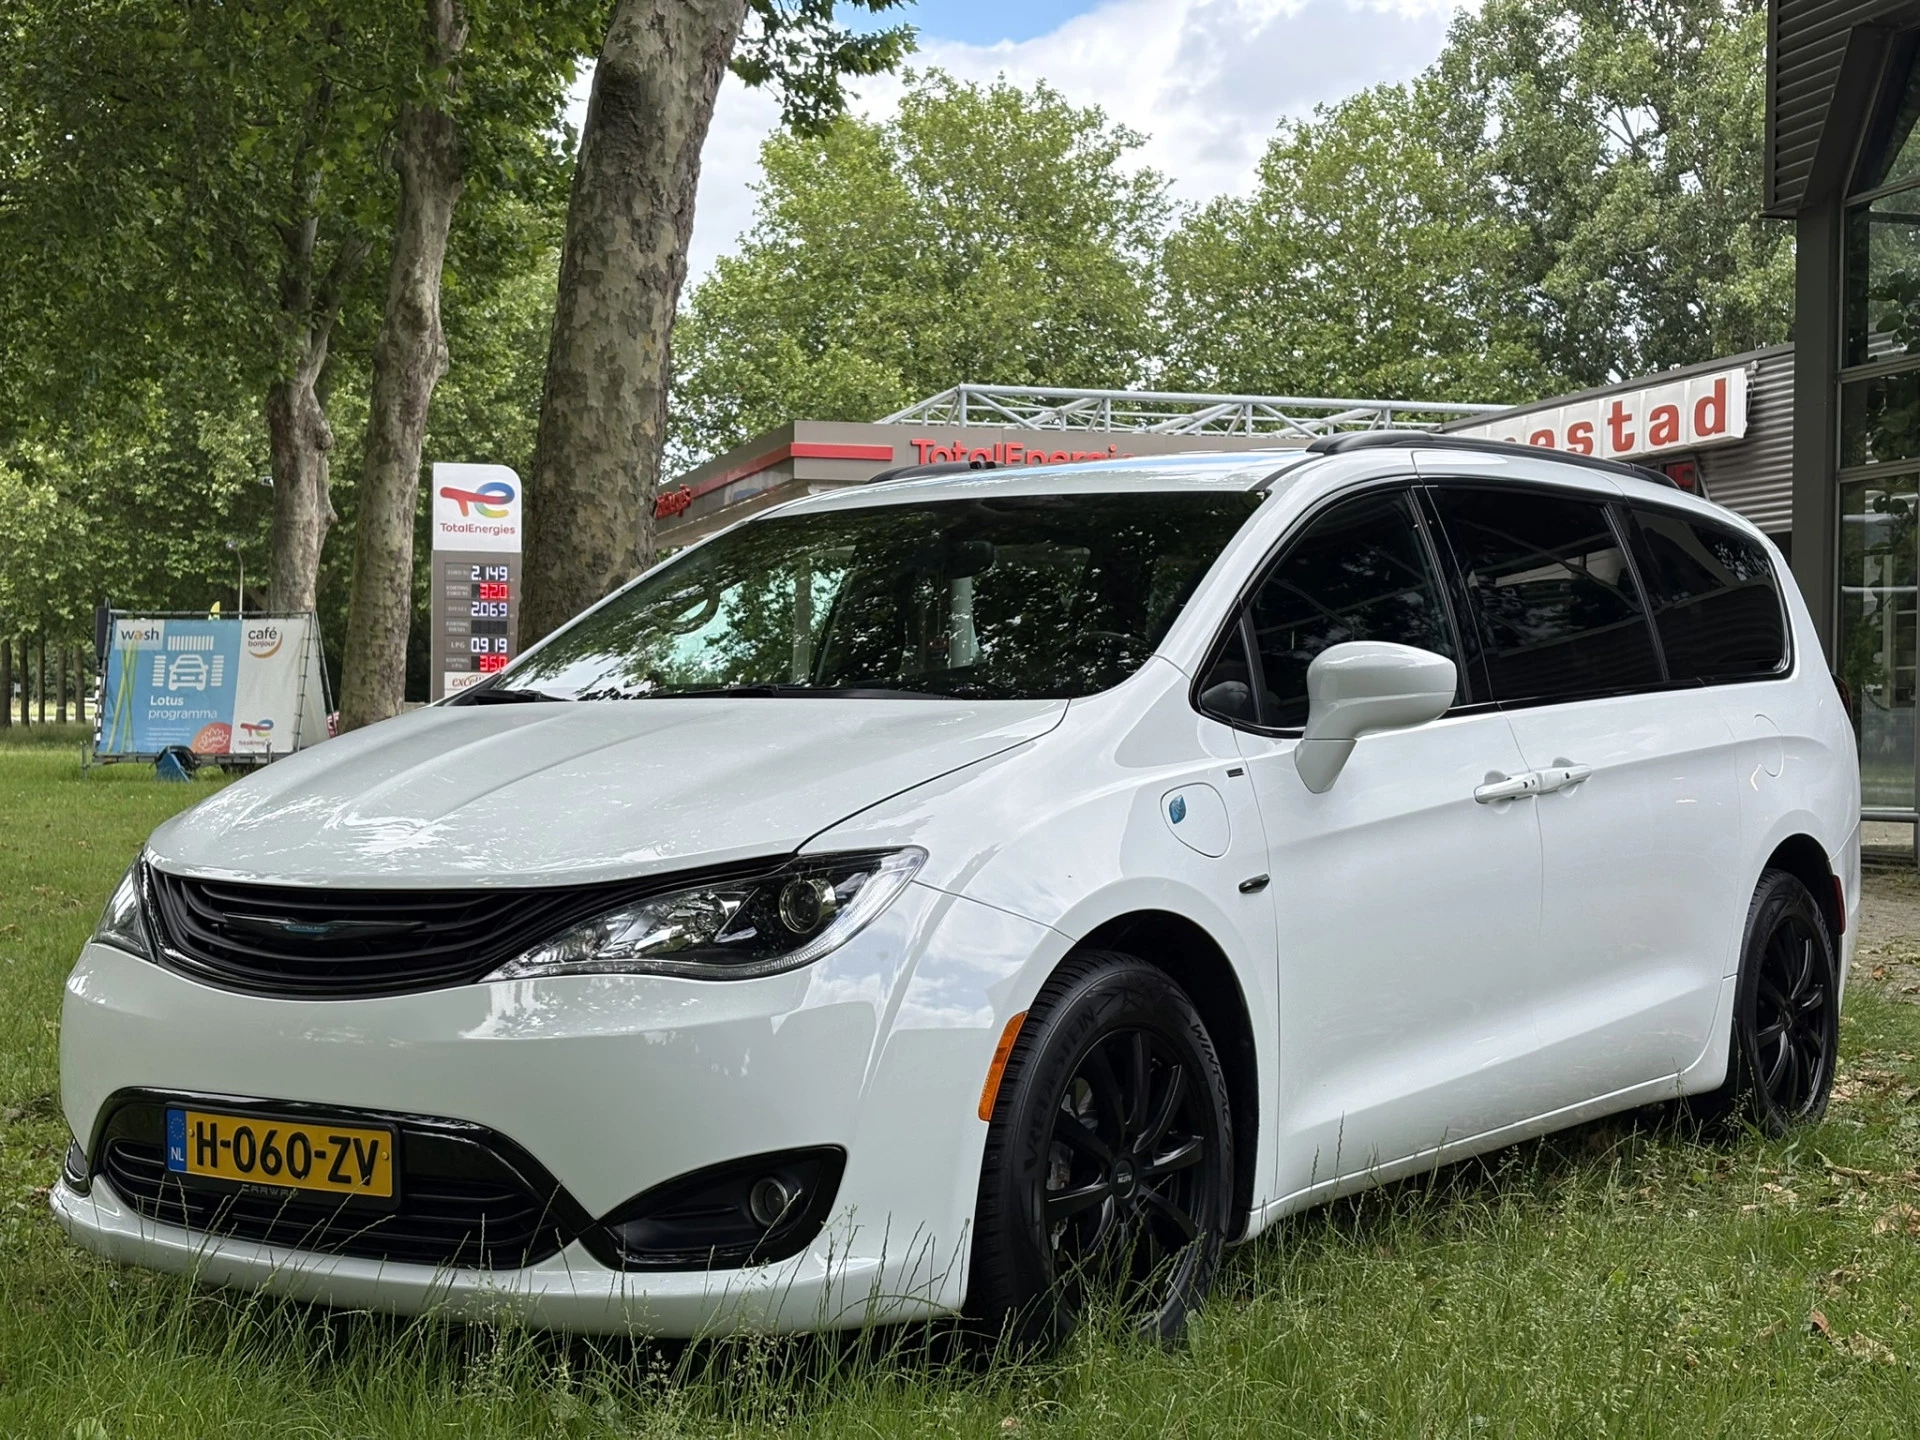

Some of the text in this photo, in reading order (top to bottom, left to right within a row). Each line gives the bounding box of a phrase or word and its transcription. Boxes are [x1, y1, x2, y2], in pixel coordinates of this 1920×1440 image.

[1503, 378, 1727, 456] estad
[440, 523, 515, 536] TotalEnergies
[471, 565, 508, 581] 2.149
[121, 627, 160, 641] wash
[248, 626, 277, 640] café
[248, 640, 276, 648] bonjour
[150, 695, 184, 706] Lotus
[149, 708, 218, 720] programma
[171, 1146, 185, 1162] NL
[195, 1121, 379, 1187] H-060-ZV
